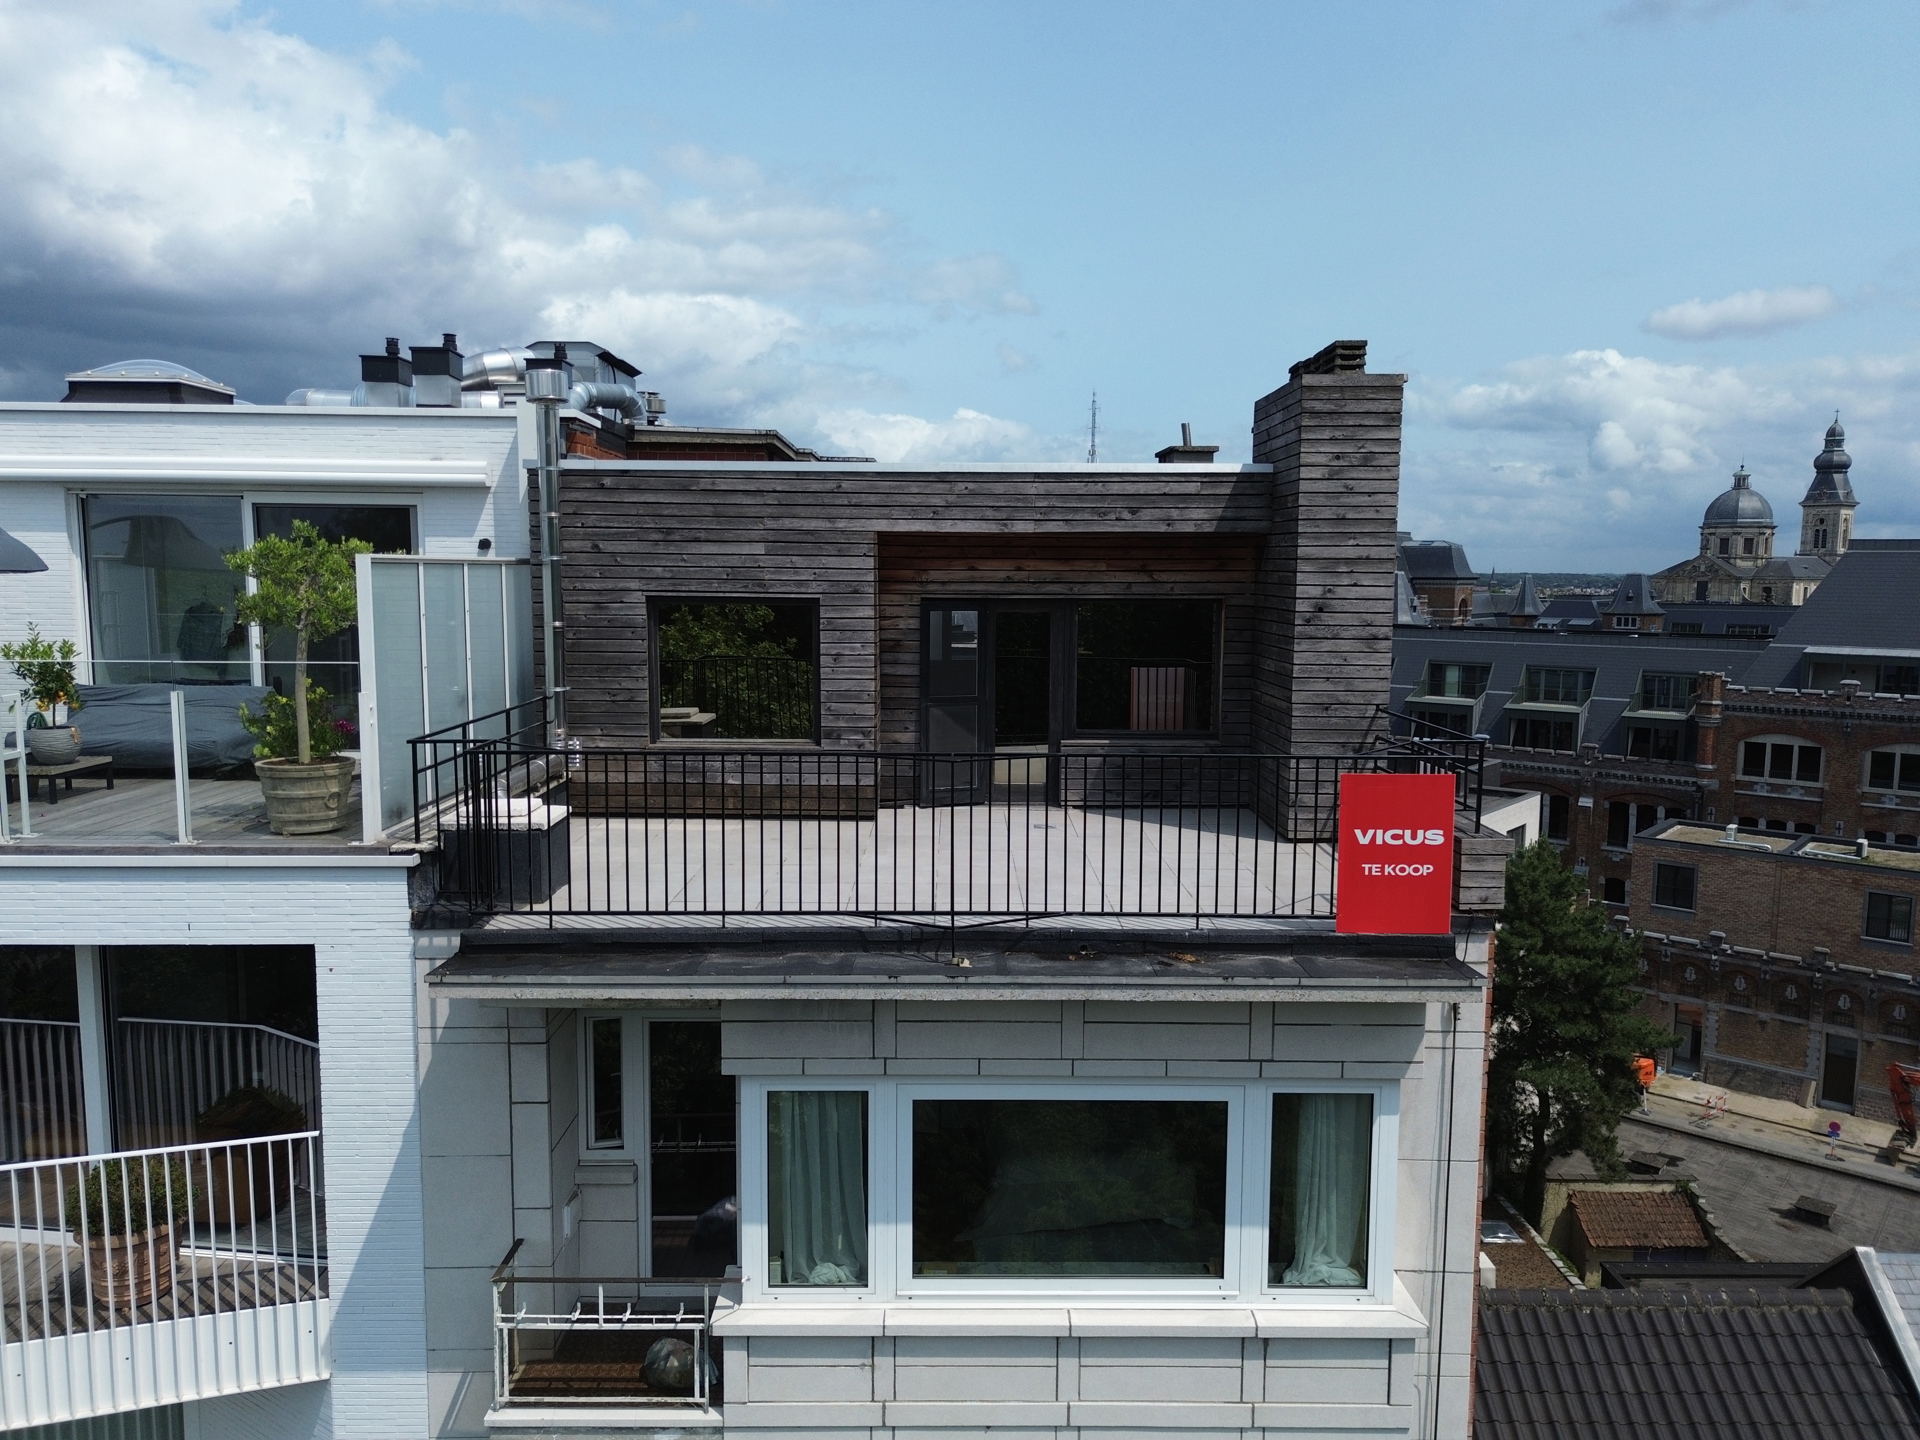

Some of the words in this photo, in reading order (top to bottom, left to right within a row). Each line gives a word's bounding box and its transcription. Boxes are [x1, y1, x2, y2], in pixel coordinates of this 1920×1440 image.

[1354, 829, 1445, 845] VICUS
[1362, 864, 1381, 876] TE
[1384, 864, 1434, 876] KOOP
